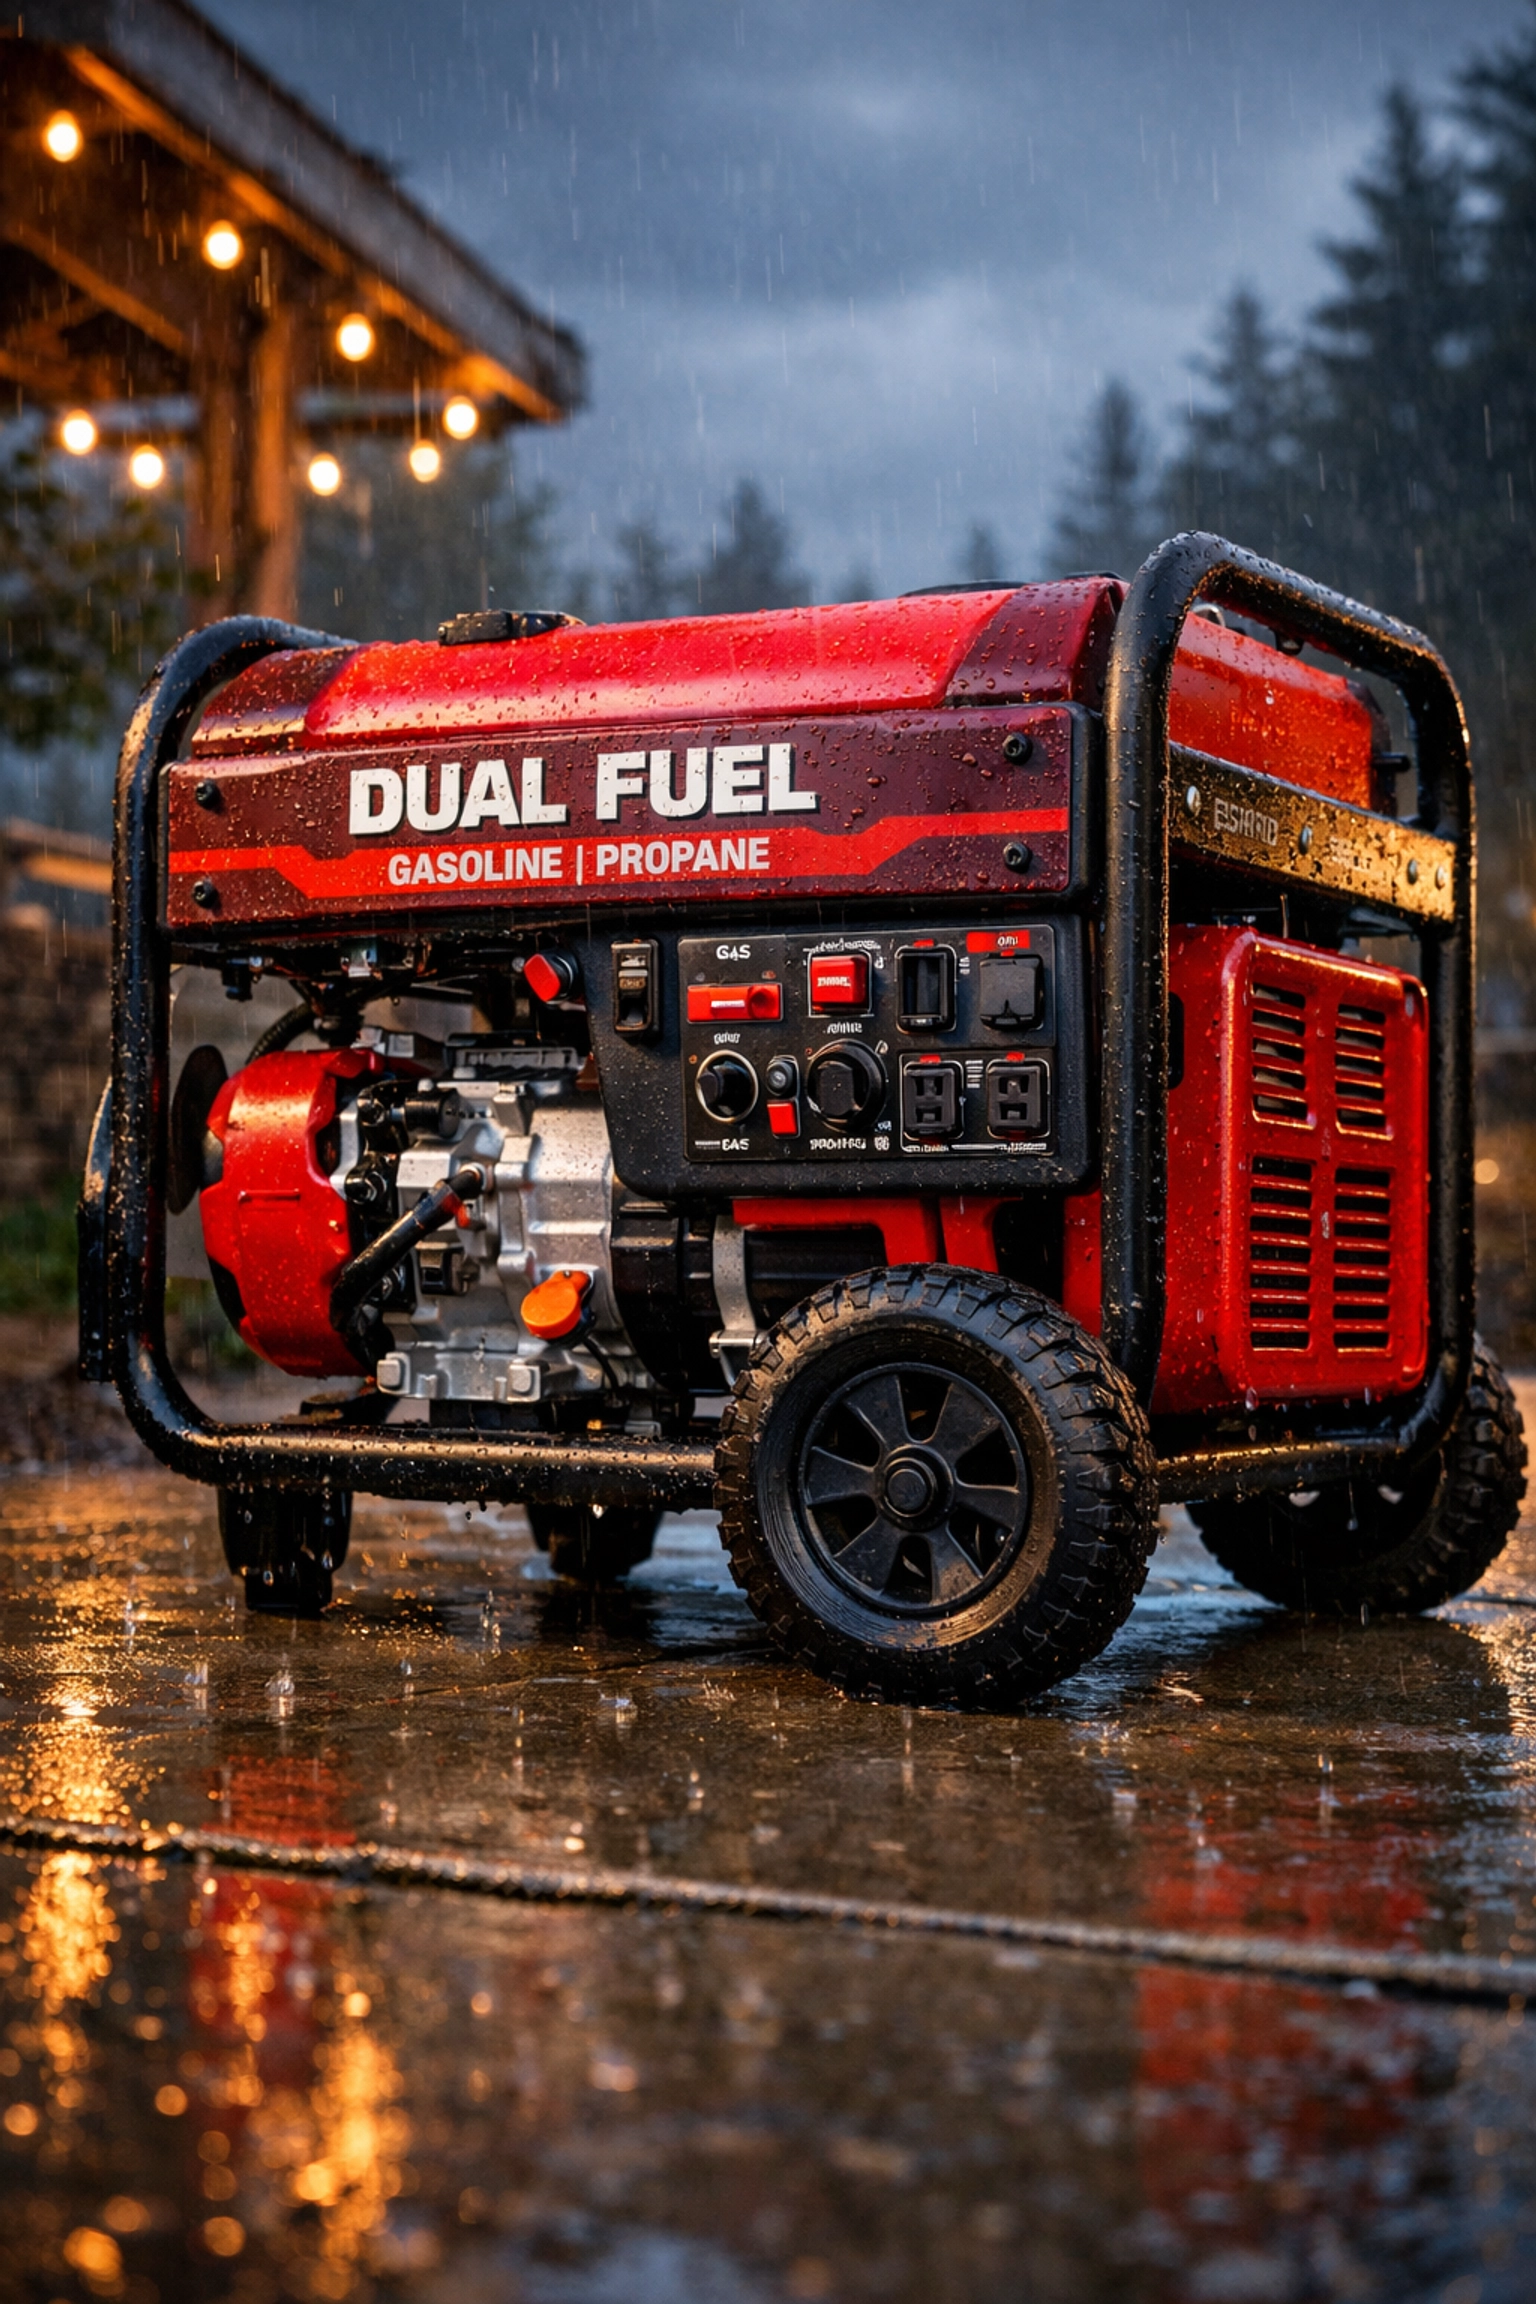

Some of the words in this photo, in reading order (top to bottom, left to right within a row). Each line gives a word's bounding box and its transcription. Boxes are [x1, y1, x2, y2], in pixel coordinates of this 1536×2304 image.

[349, 757, 567, 835] DUAL
[596, 743, 817, 820] FUEL
[388, 846, 563, 886] GASOLINE
[596, 837, 771, 876] PROPANE
